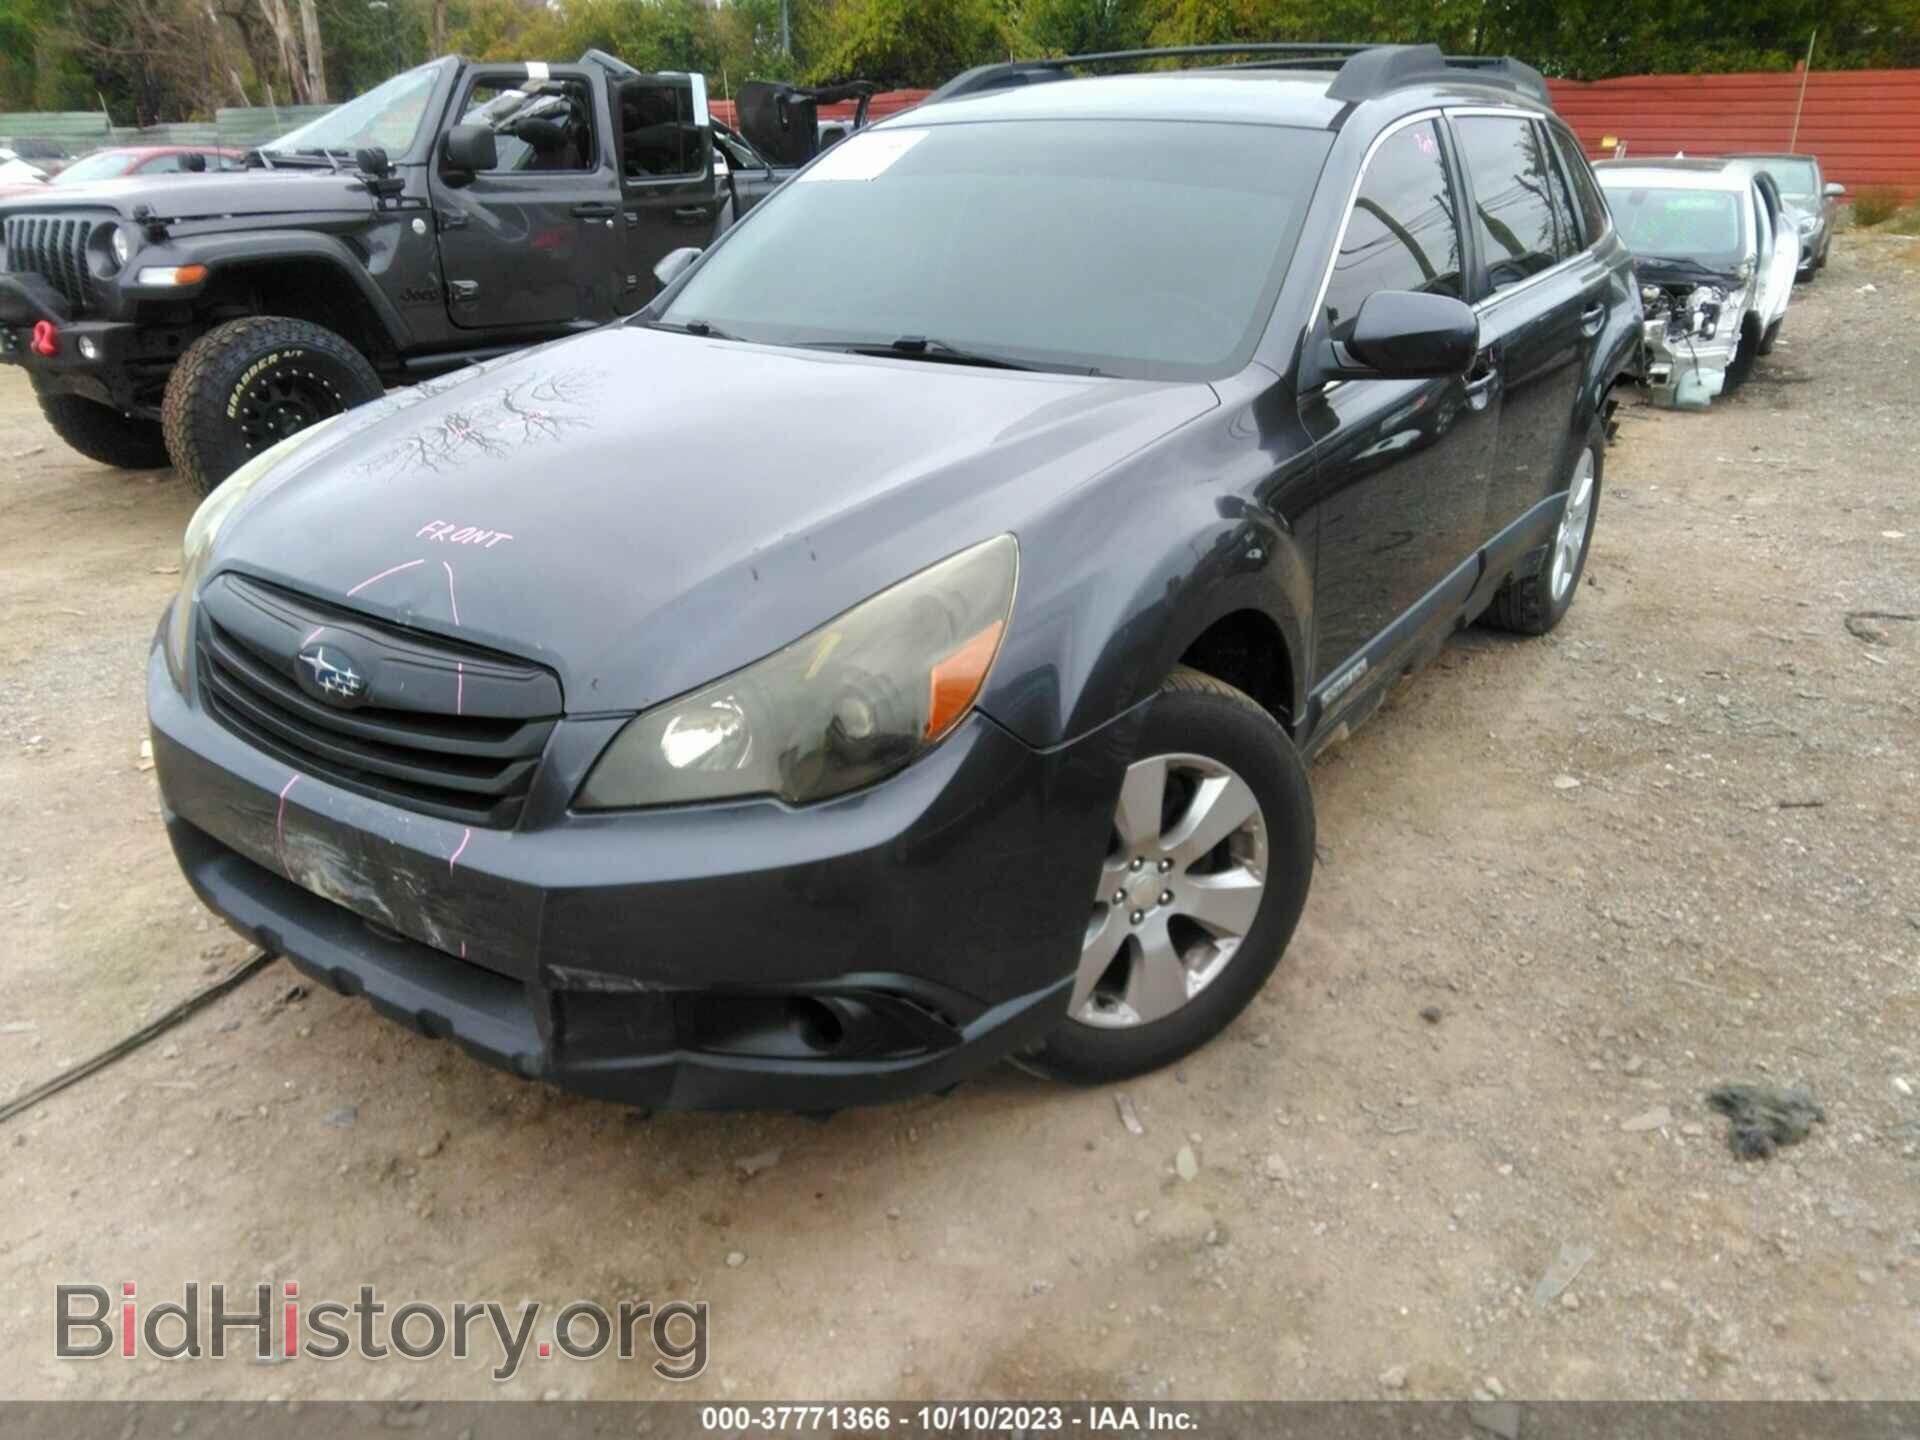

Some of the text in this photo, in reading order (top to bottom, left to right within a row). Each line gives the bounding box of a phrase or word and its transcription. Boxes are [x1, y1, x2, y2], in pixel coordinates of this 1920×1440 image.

[226, 349, 304, 419] GRABBER A/T
[415, 519, 513, 549] FRONT
